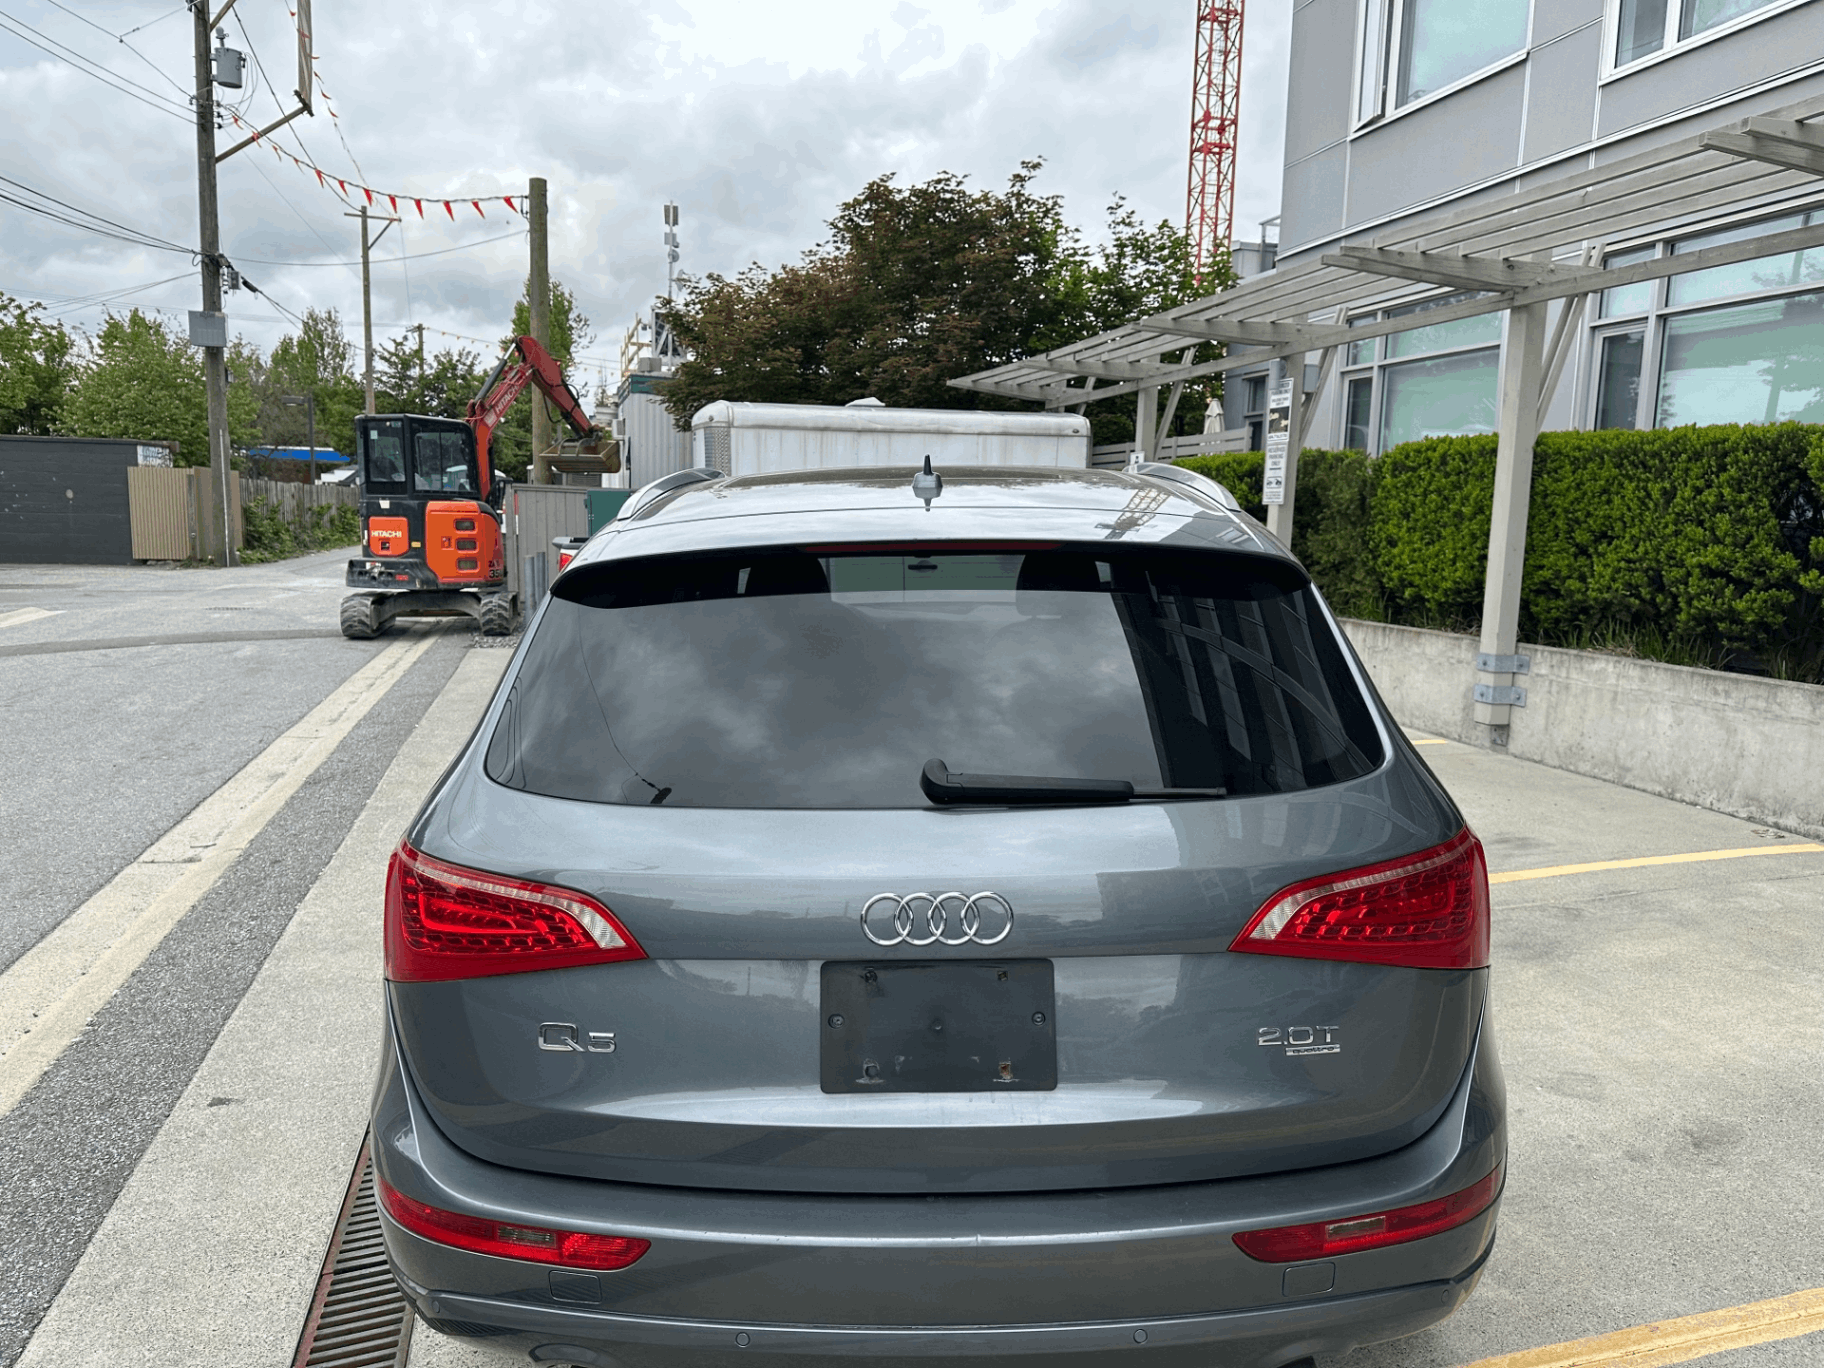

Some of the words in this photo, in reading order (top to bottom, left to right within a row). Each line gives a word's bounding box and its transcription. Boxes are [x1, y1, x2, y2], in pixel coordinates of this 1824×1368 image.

[495, 385, 520, 414] HITACH
[371, 530, 402, 538] HITACHI
[538, 1022, 616, 1053] Q5
[1258, 1026, 1339, 1046] 2.0T
[1291, 1046, 1336, 1055] quattro
